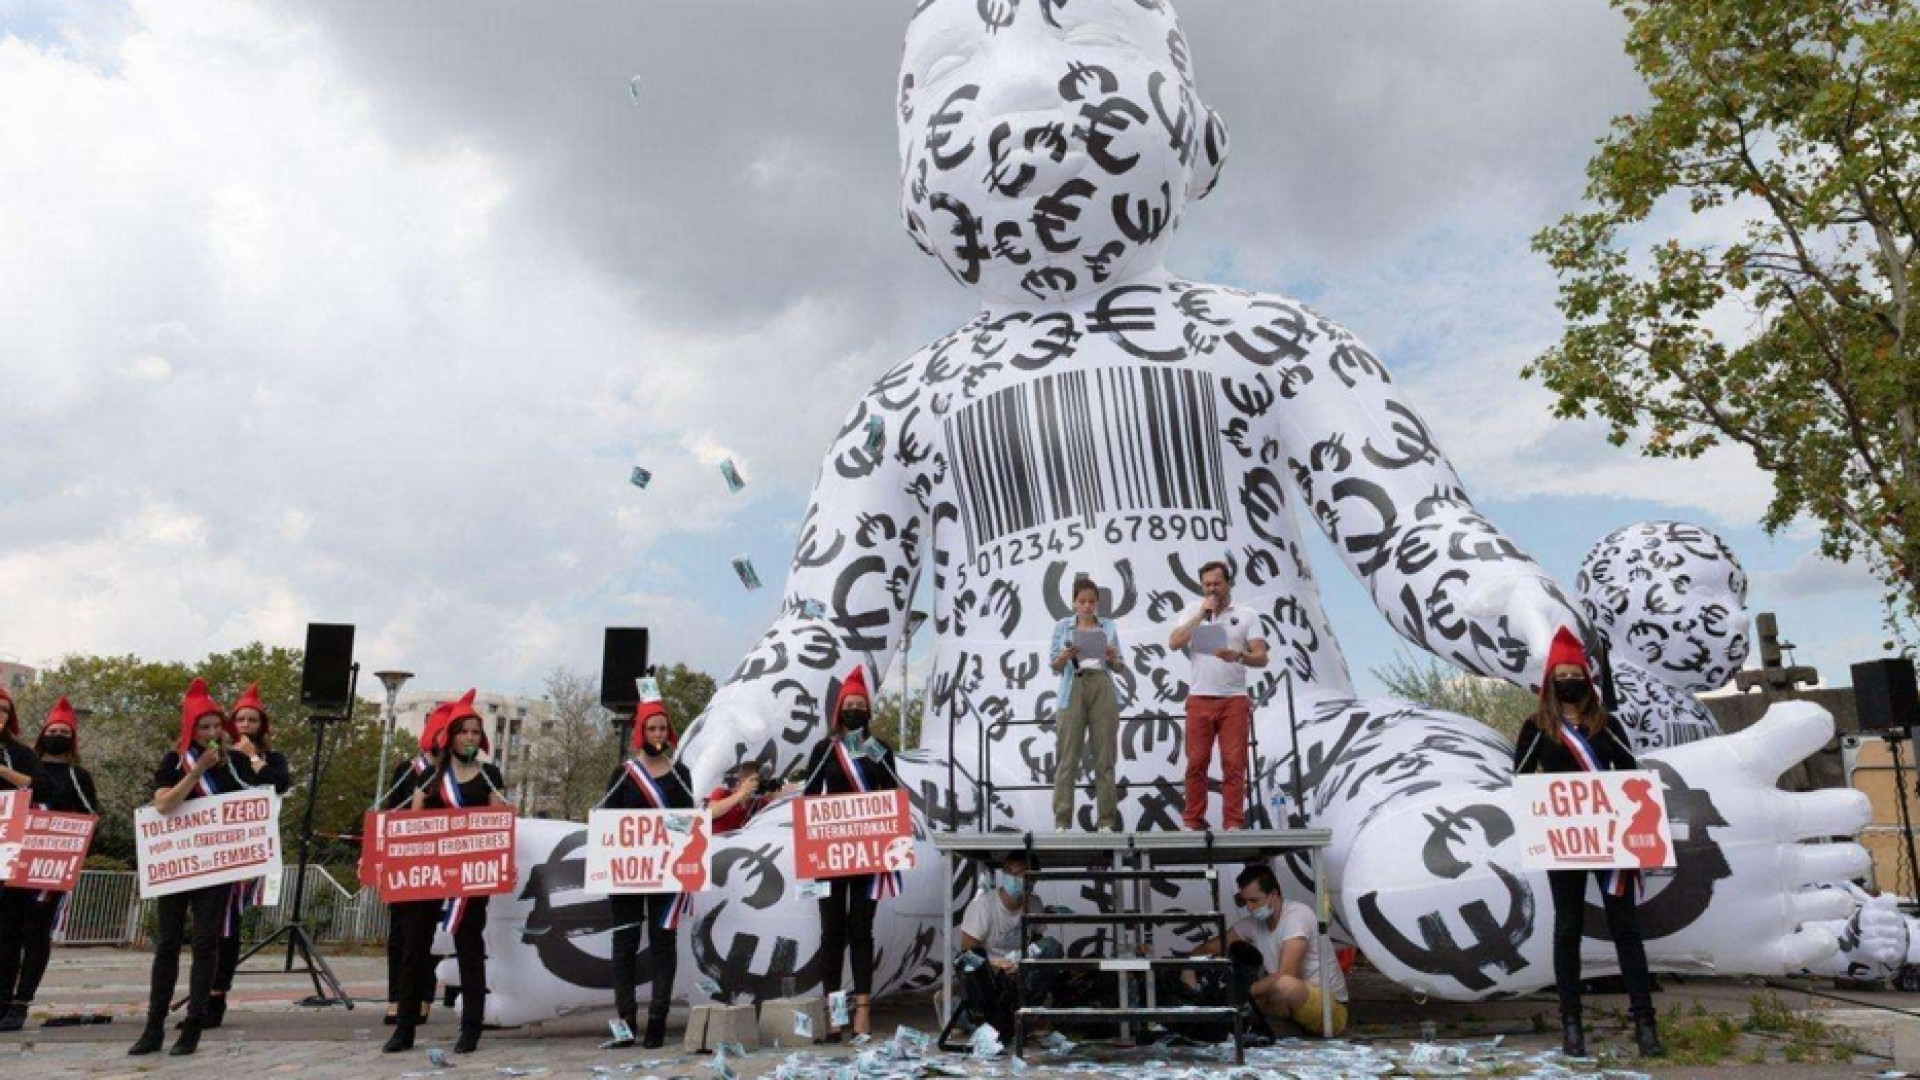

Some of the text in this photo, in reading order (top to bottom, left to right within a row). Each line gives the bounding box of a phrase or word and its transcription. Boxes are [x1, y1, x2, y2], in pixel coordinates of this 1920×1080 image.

[956, 515, 1228, 590] 5 012345 678900
[810, 794, 893, 823] ABOLITION
[807, 819, 899, 840] INTERNATIONALE
[147, 855, 200, 881] DROITS
[388, 870, 408, 890] LA
